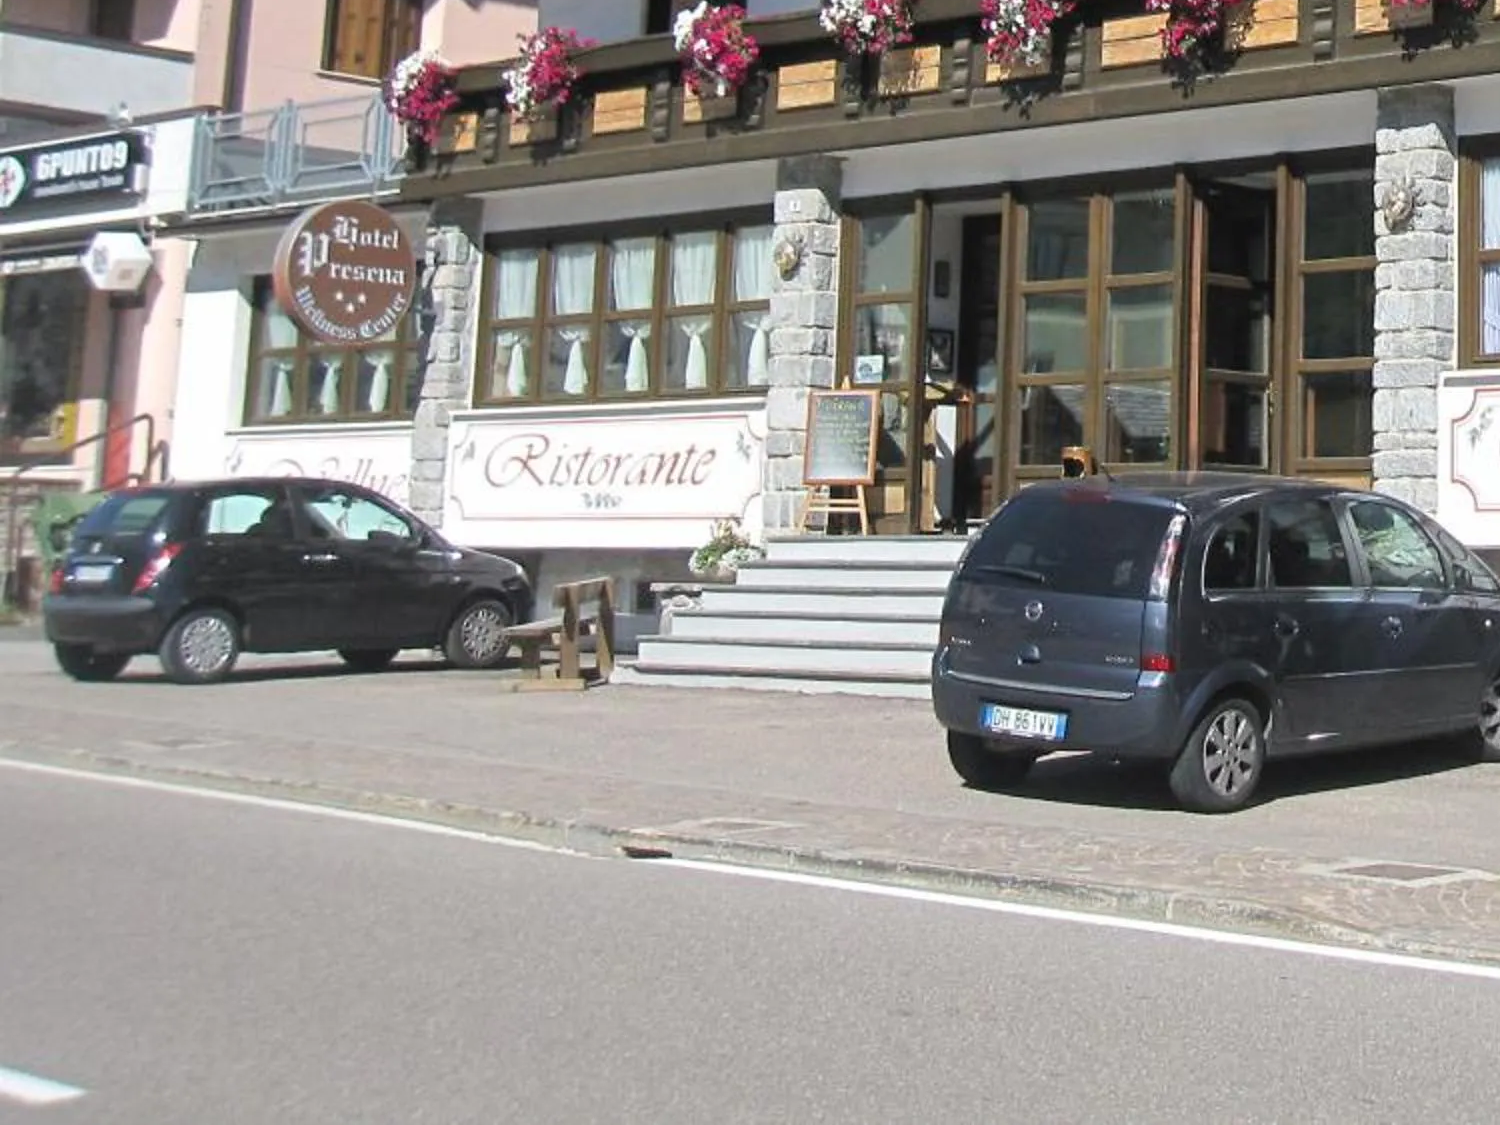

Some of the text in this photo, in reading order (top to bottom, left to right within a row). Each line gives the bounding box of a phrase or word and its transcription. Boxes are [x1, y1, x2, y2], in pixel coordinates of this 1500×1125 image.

[298, 230, 406, 286] Presena
[333, 215, 400, 252] Hotel
[485, 433, 717, 488] Ristorante
